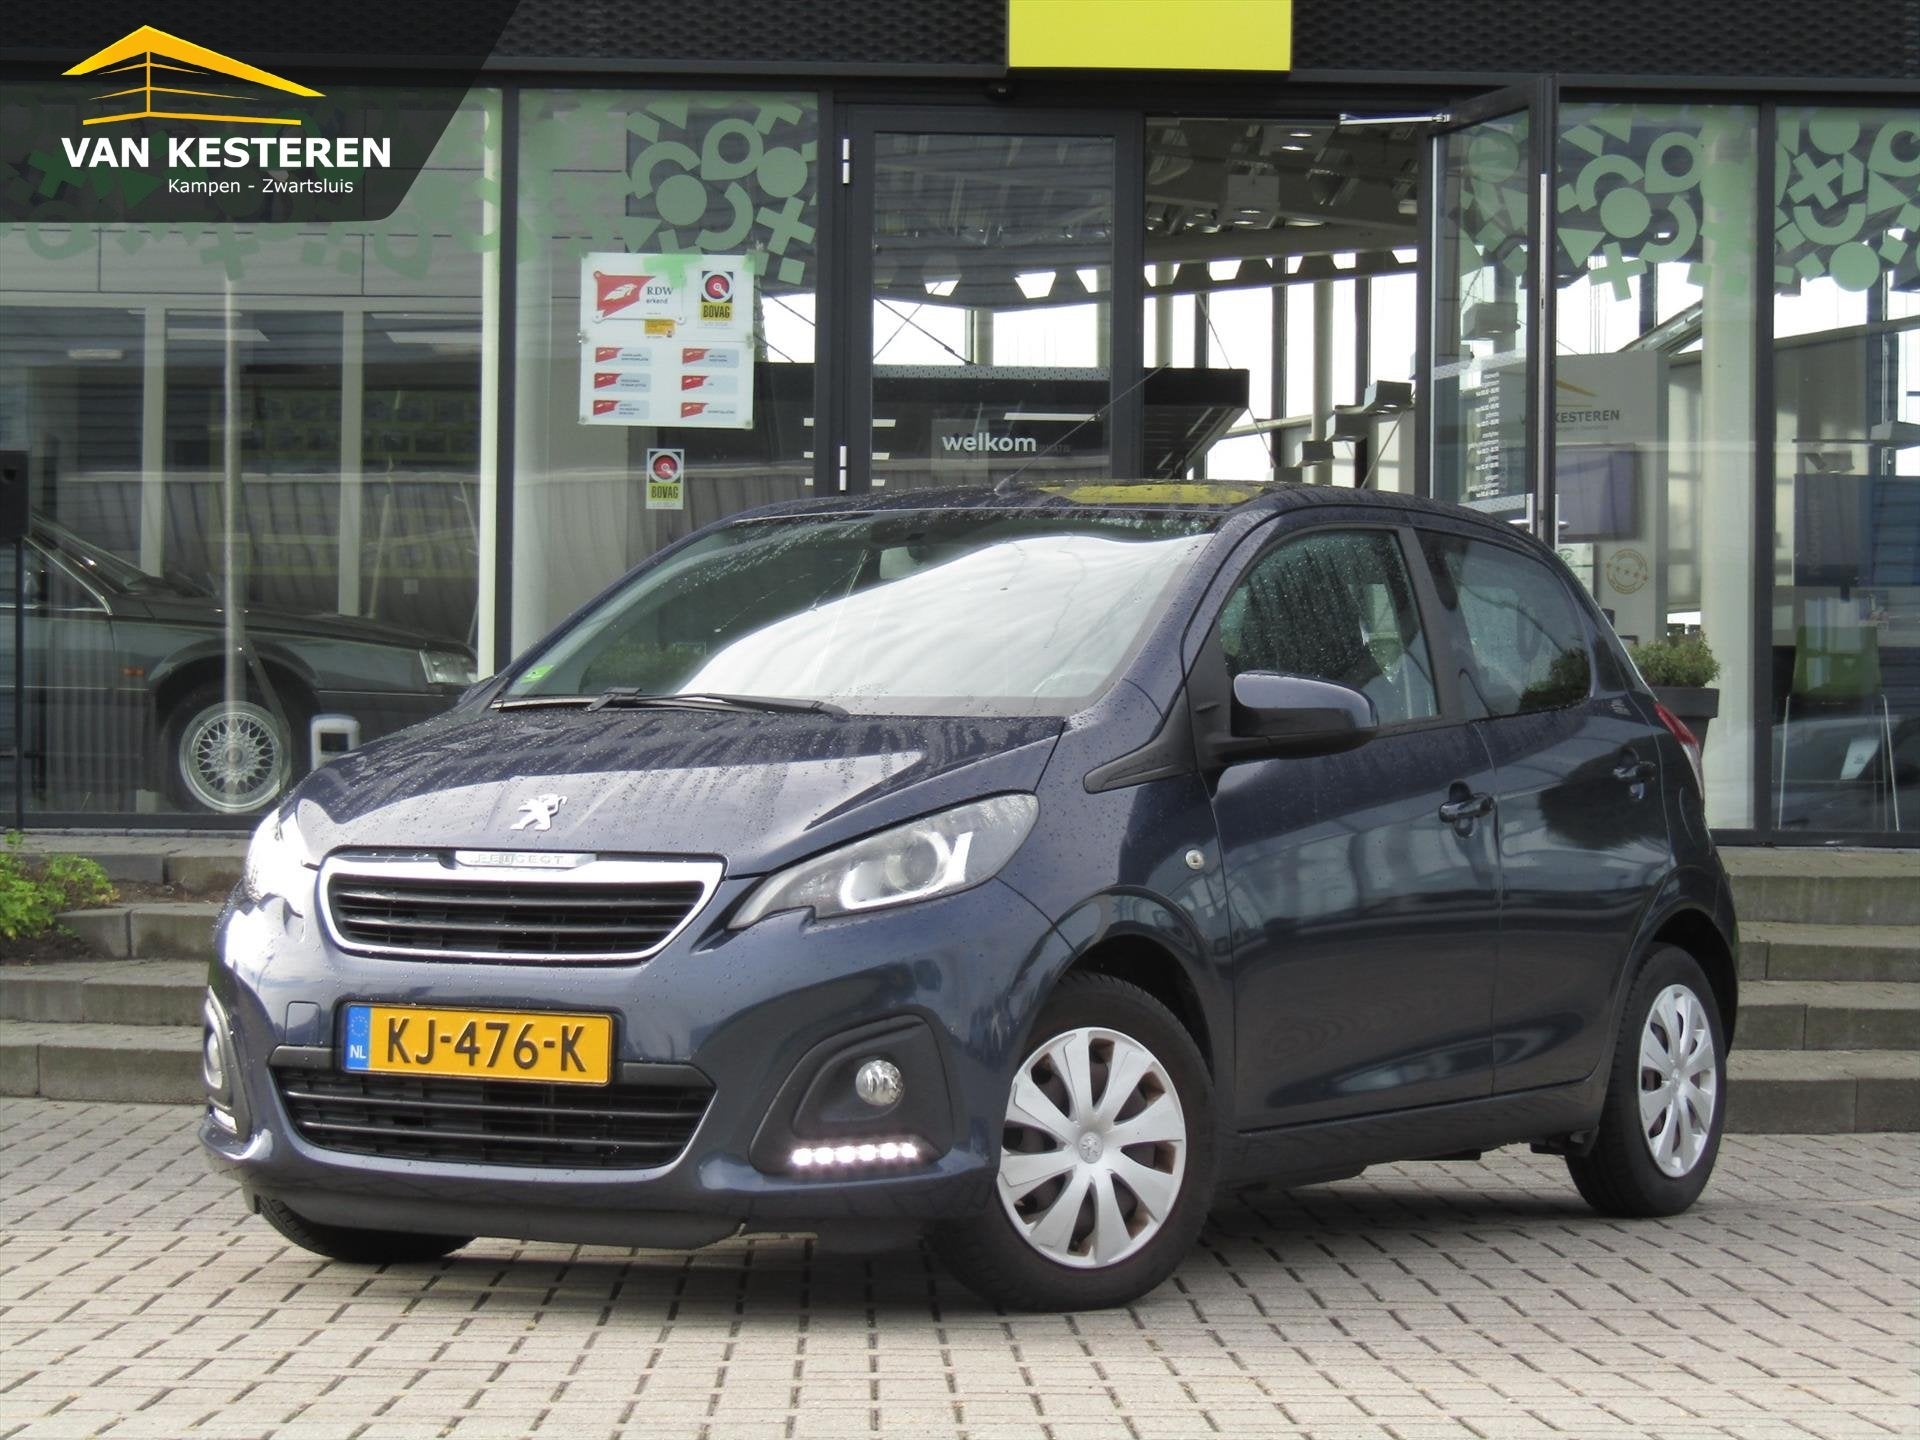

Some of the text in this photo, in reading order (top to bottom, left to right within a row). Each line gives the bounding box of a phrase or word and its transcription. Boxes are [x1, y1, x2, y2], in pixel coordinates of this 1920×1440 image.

[646, 286, 673, 296] RDW
[703, 305, 730, 318] BOVAG
[942, 432, 1037, 452] welkom
[651, 485, 679, 499] BOVAG
[473, 853, 564, 866] PEUGEOT
[350, 1045, 367, 1058] NL
[387, 1016, 587, 1074] KJ-476-K
